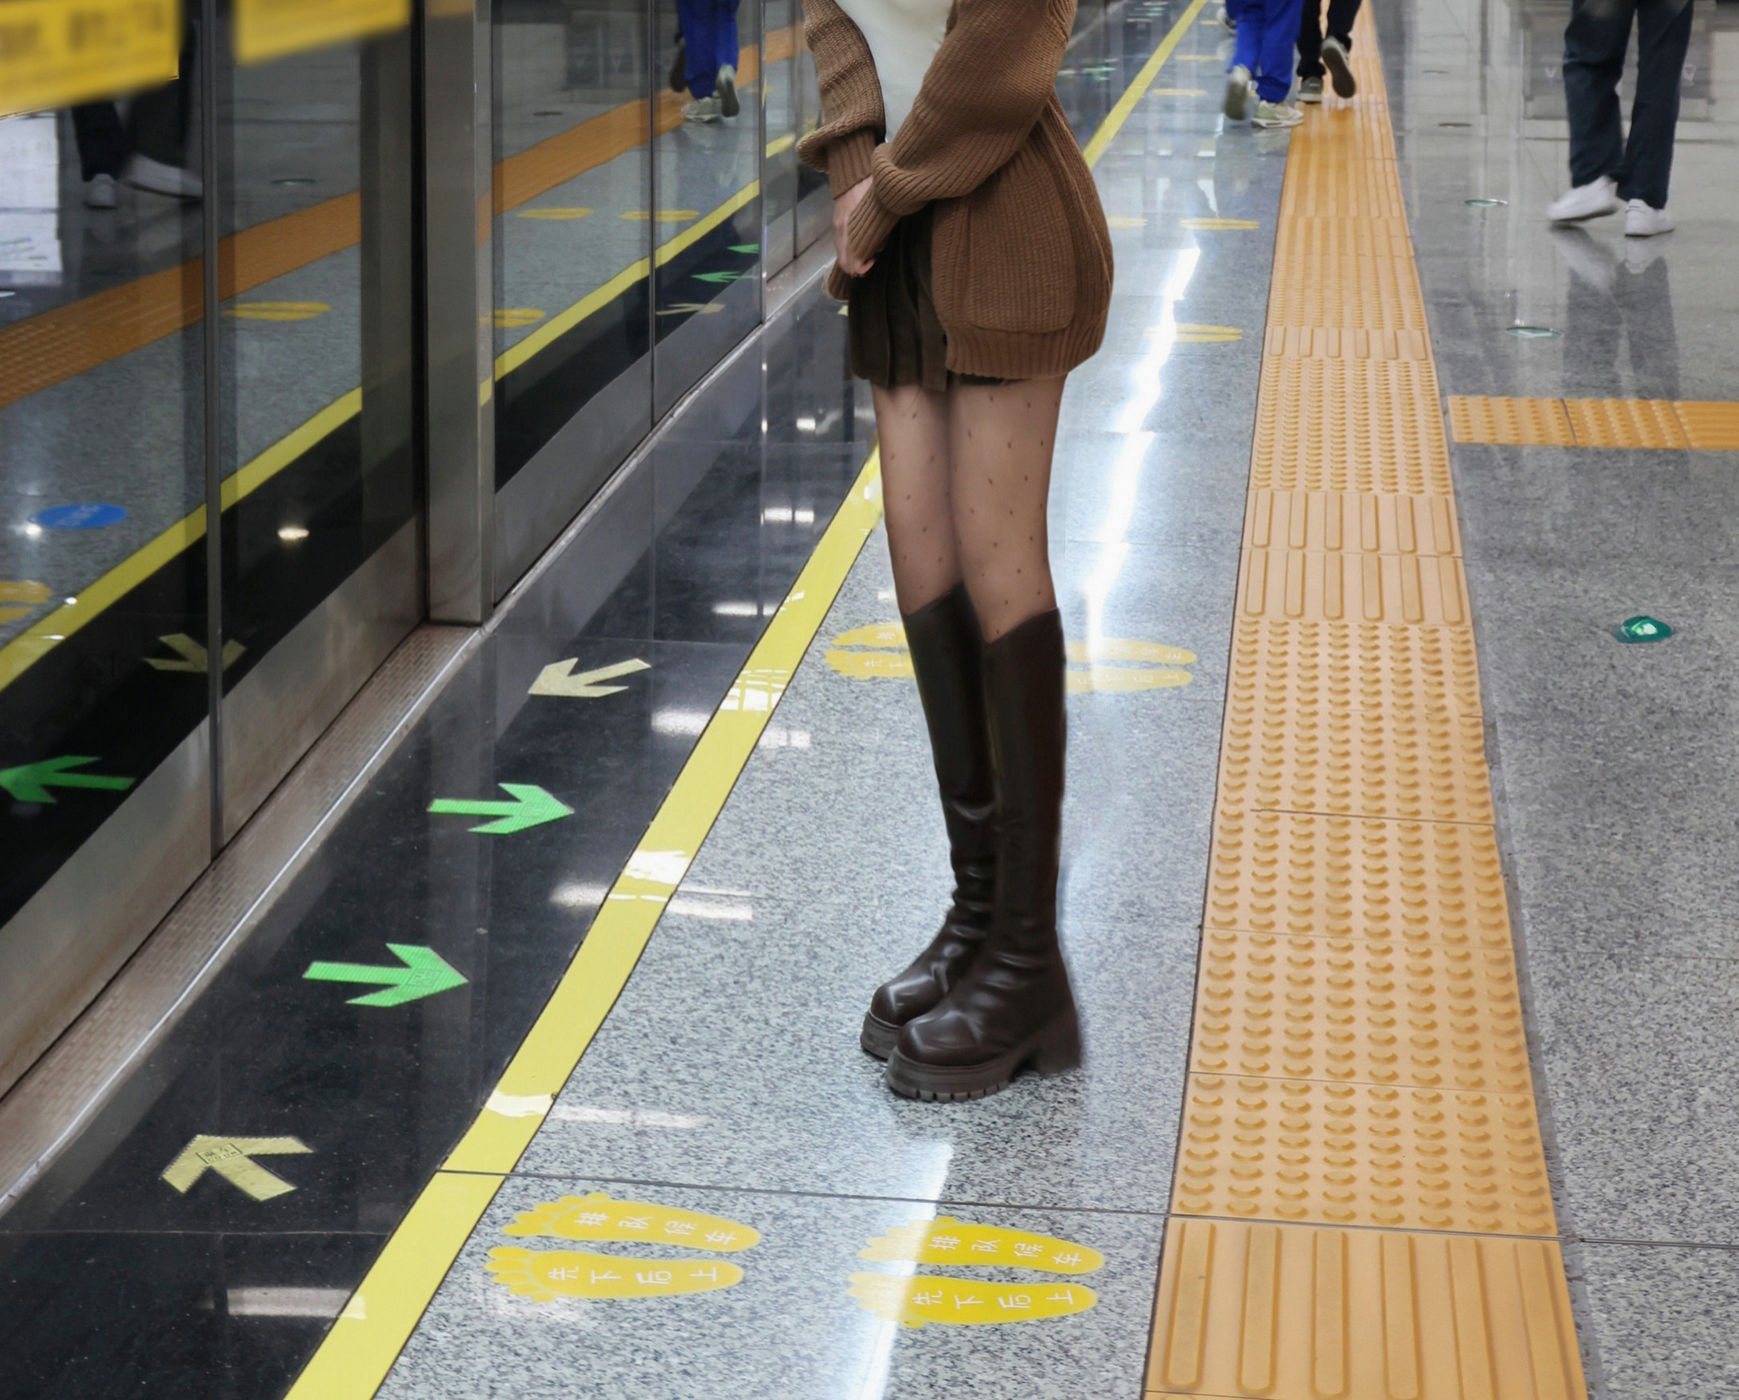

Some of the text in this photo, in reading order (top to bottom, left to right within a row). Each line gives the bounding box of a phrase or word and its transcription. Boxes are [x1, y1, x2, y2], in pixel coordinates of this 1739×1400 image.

[574, 1211, 738, 1246] 排队候车
[928, 1235, 1083, 1267] 排队候车
[548, 1265, 718, 1285] 先下后上
[912, 1290, 1075, 1310] 先下后上
